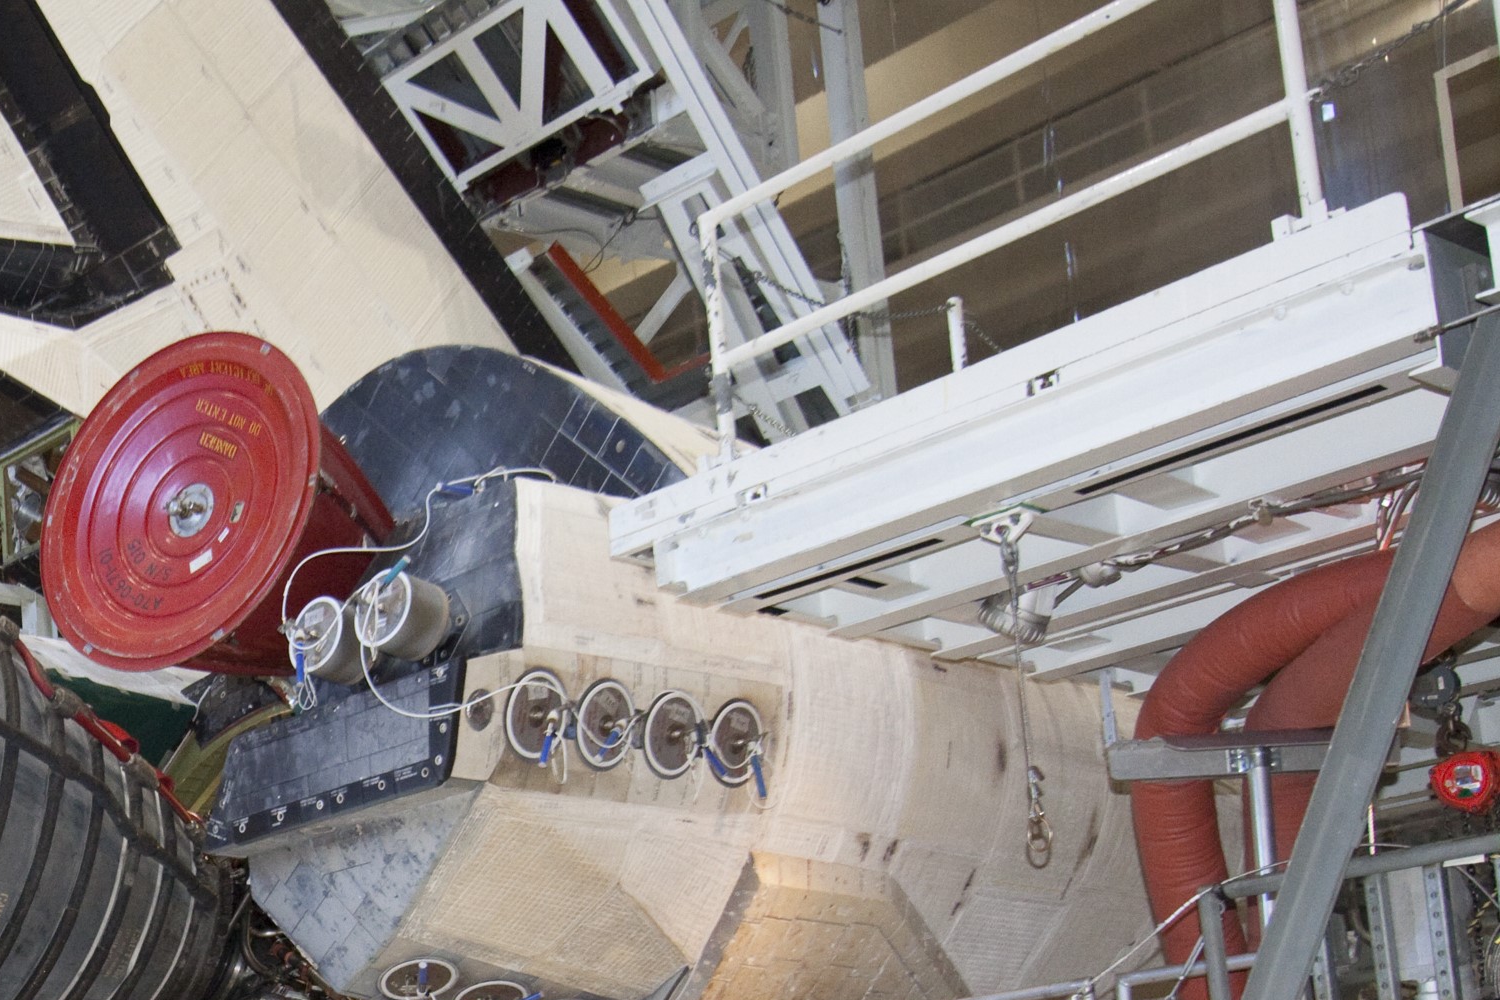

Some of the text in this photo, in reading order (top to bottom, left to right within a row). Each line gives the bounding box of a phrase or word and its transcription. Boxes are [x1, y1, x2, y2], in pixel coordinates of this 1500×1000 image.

[180, 361, 205, 379] AREA
[195, 397, 262, 437] DO NOT ENTER
[199, 431, 238, 460] DANGER
